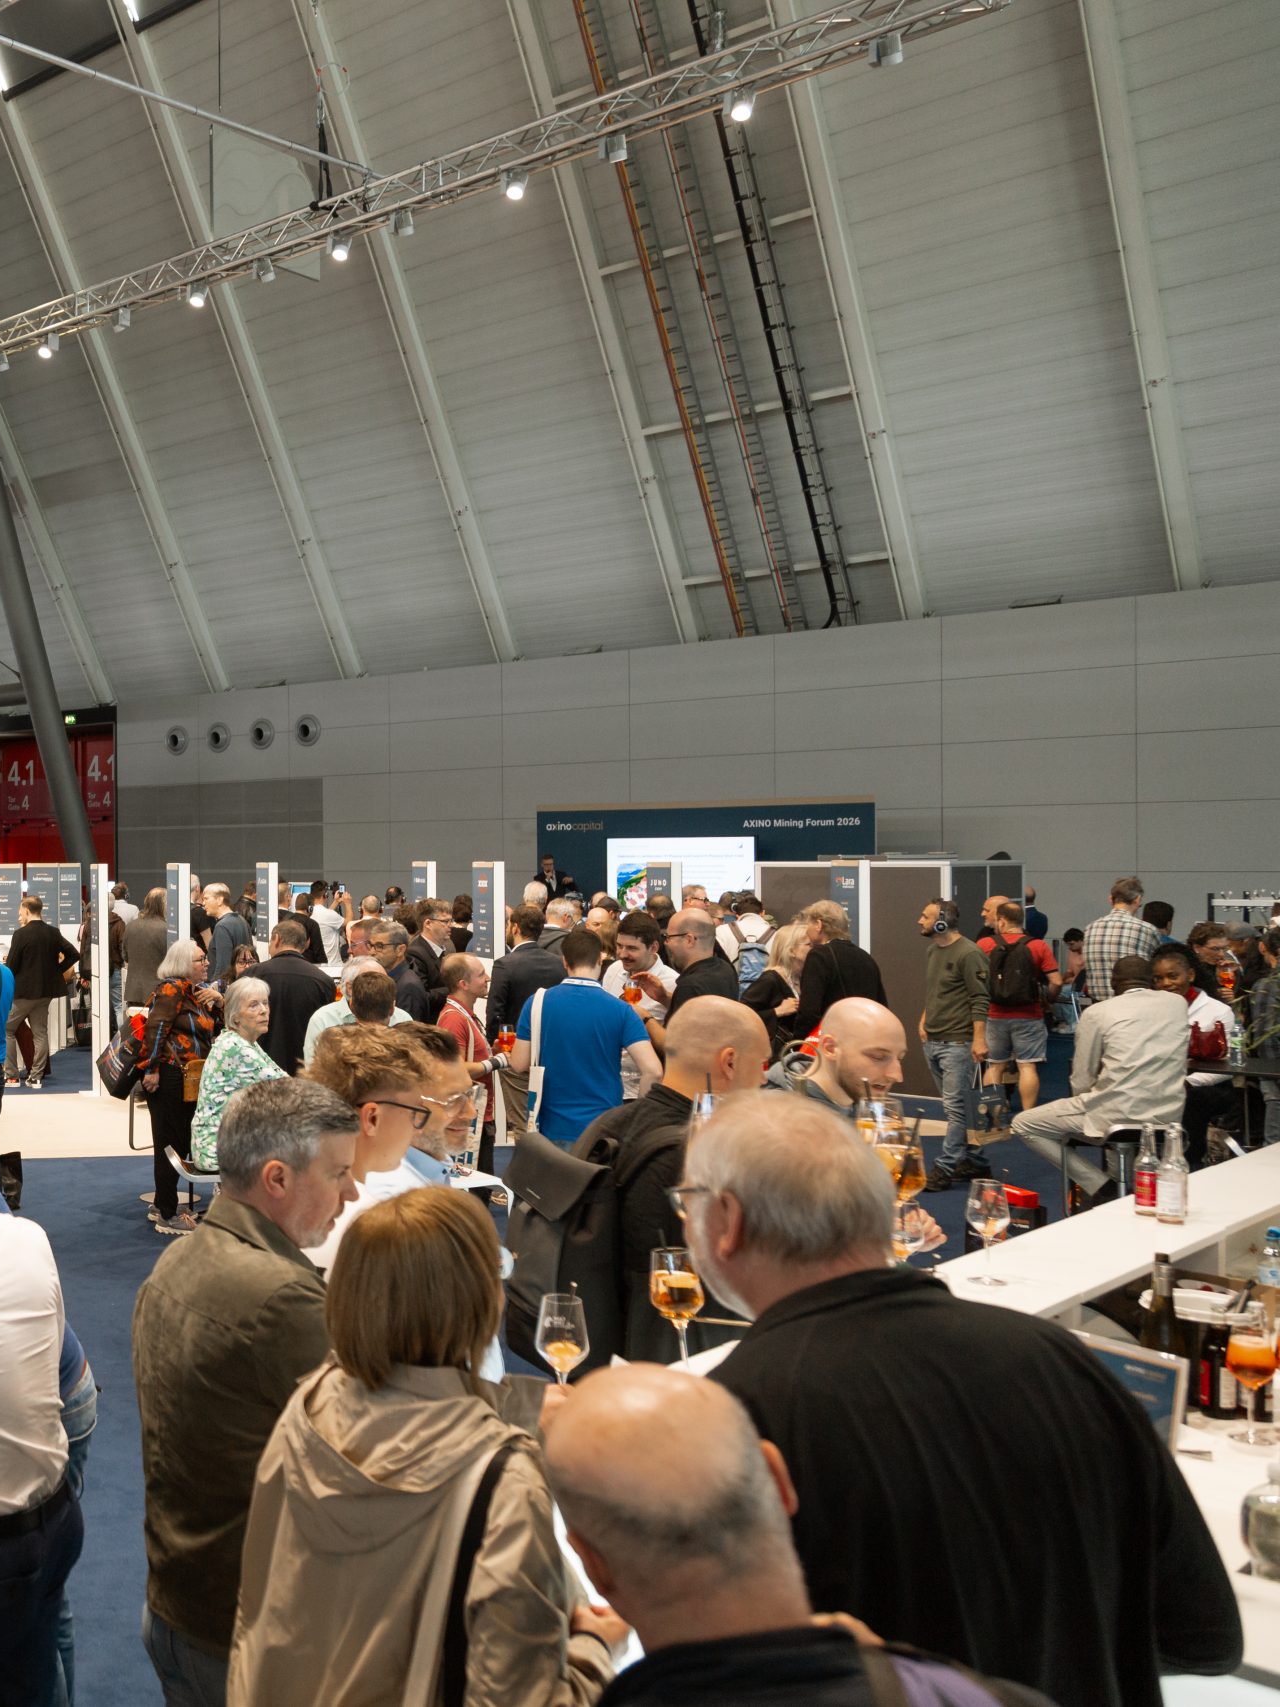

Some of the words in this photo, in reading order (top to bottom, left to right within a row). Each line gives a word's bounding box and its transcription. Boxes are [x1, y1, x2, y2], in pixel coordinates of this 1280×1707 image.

[7, 760, 34, 786] 4.1
[22, 795, 29, 810] 4
[102, 791, 111, 807] 4
[743, 819, 771, 828] AXINO
[774, 819, 803, 829] Mining
[806, 818, 834, 826] Forum
[837, 817, 861, 826] 2026
[650, 879, 667, 887] JUNO
[842, 876, 854, 886] Lara
